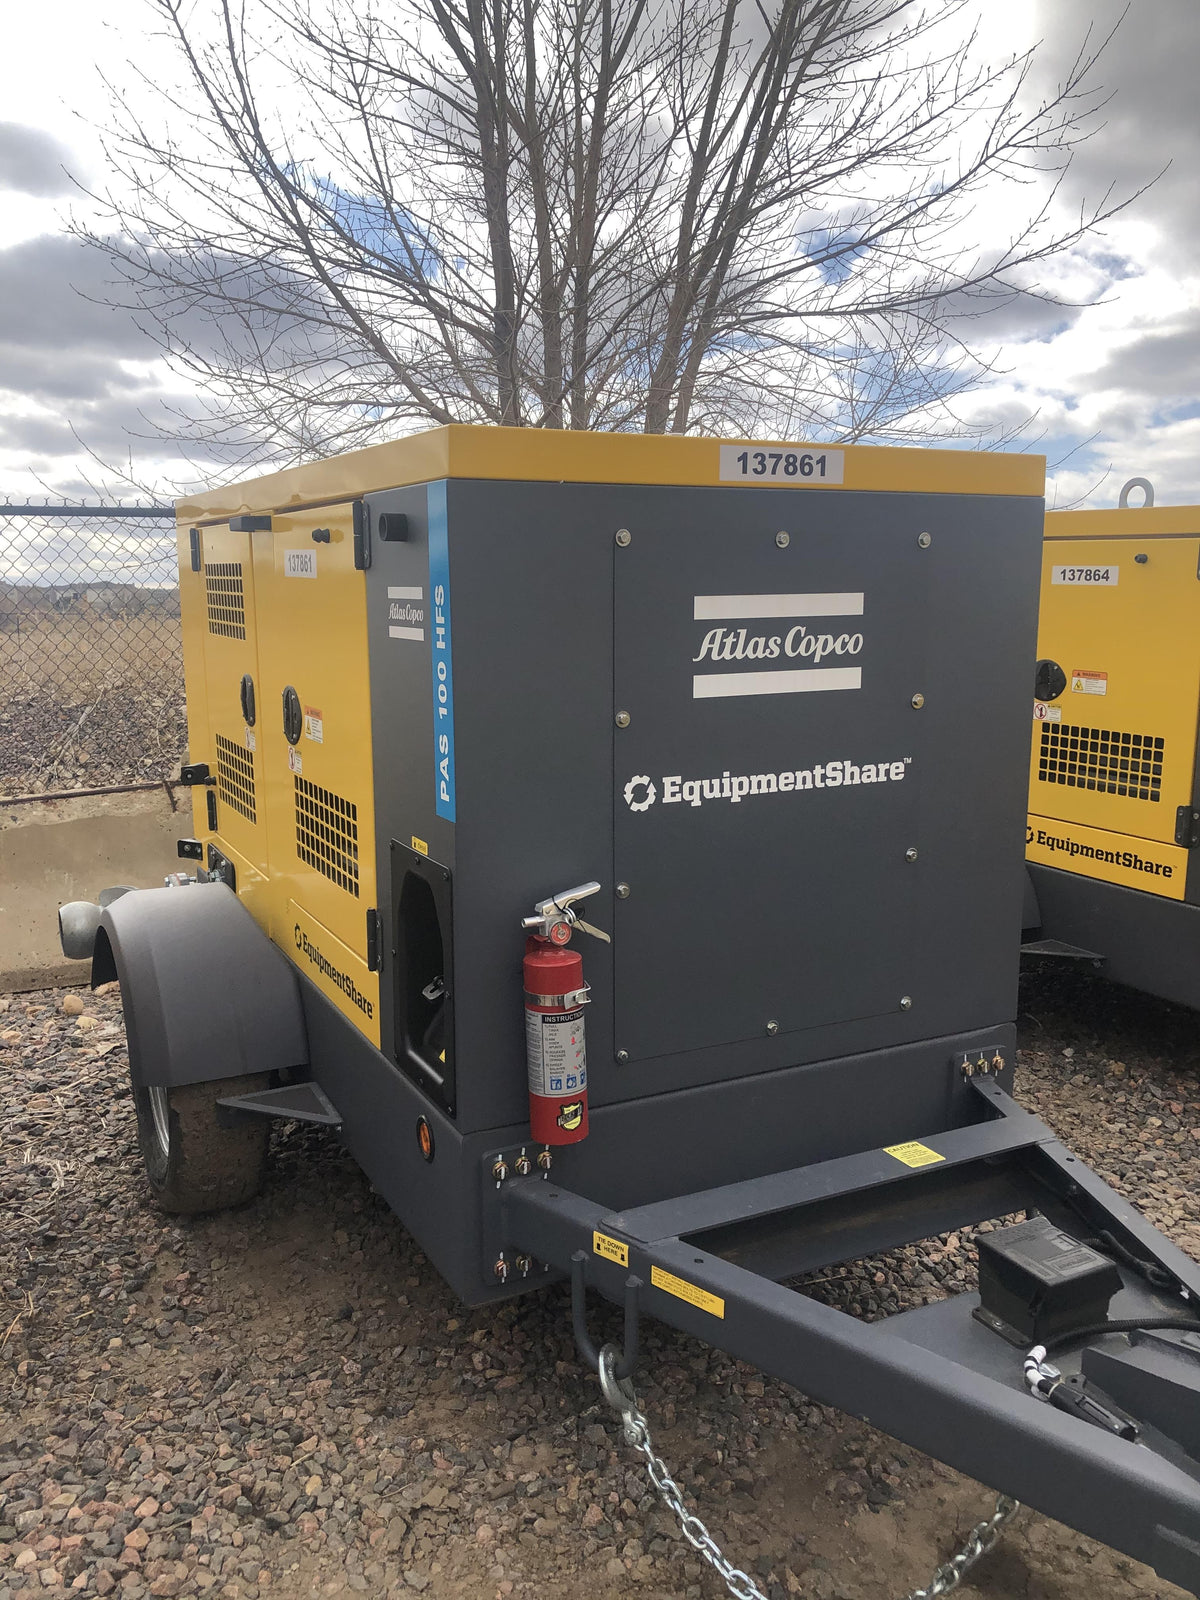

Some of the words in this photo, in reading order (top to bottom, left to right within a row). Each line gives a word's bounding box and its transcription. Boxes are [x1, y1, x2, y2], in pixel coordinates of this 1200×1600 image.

[737, 451, 827, 477] 137861
[287, 554, 313, 573] 137861
[1060, 568, 1110, 582] 137864
[388, 602, 406, 621] Atlas
[405, 604, 424, 624] Copco
[434, 583, 446, 650] HFS
[692, 627, 782, 662] Atlas
[784, 625, 864, 663] Copco
[437, 661, 449, 720] 100
[439, 733, 450, 803] PAS
[662, 759, 905, 807] EquipmentShare
[1036, 829, 1173, 878] EquipmentShare
[302, 932, 373, 1020] EquipmentShare
[887, 1142, 919, 1153] CAUTION
[598, 1236, 607, 1245] TIE
[607, 1240, 625, 1252] DOWN
[603, 1246, 618, 1256] HERE
